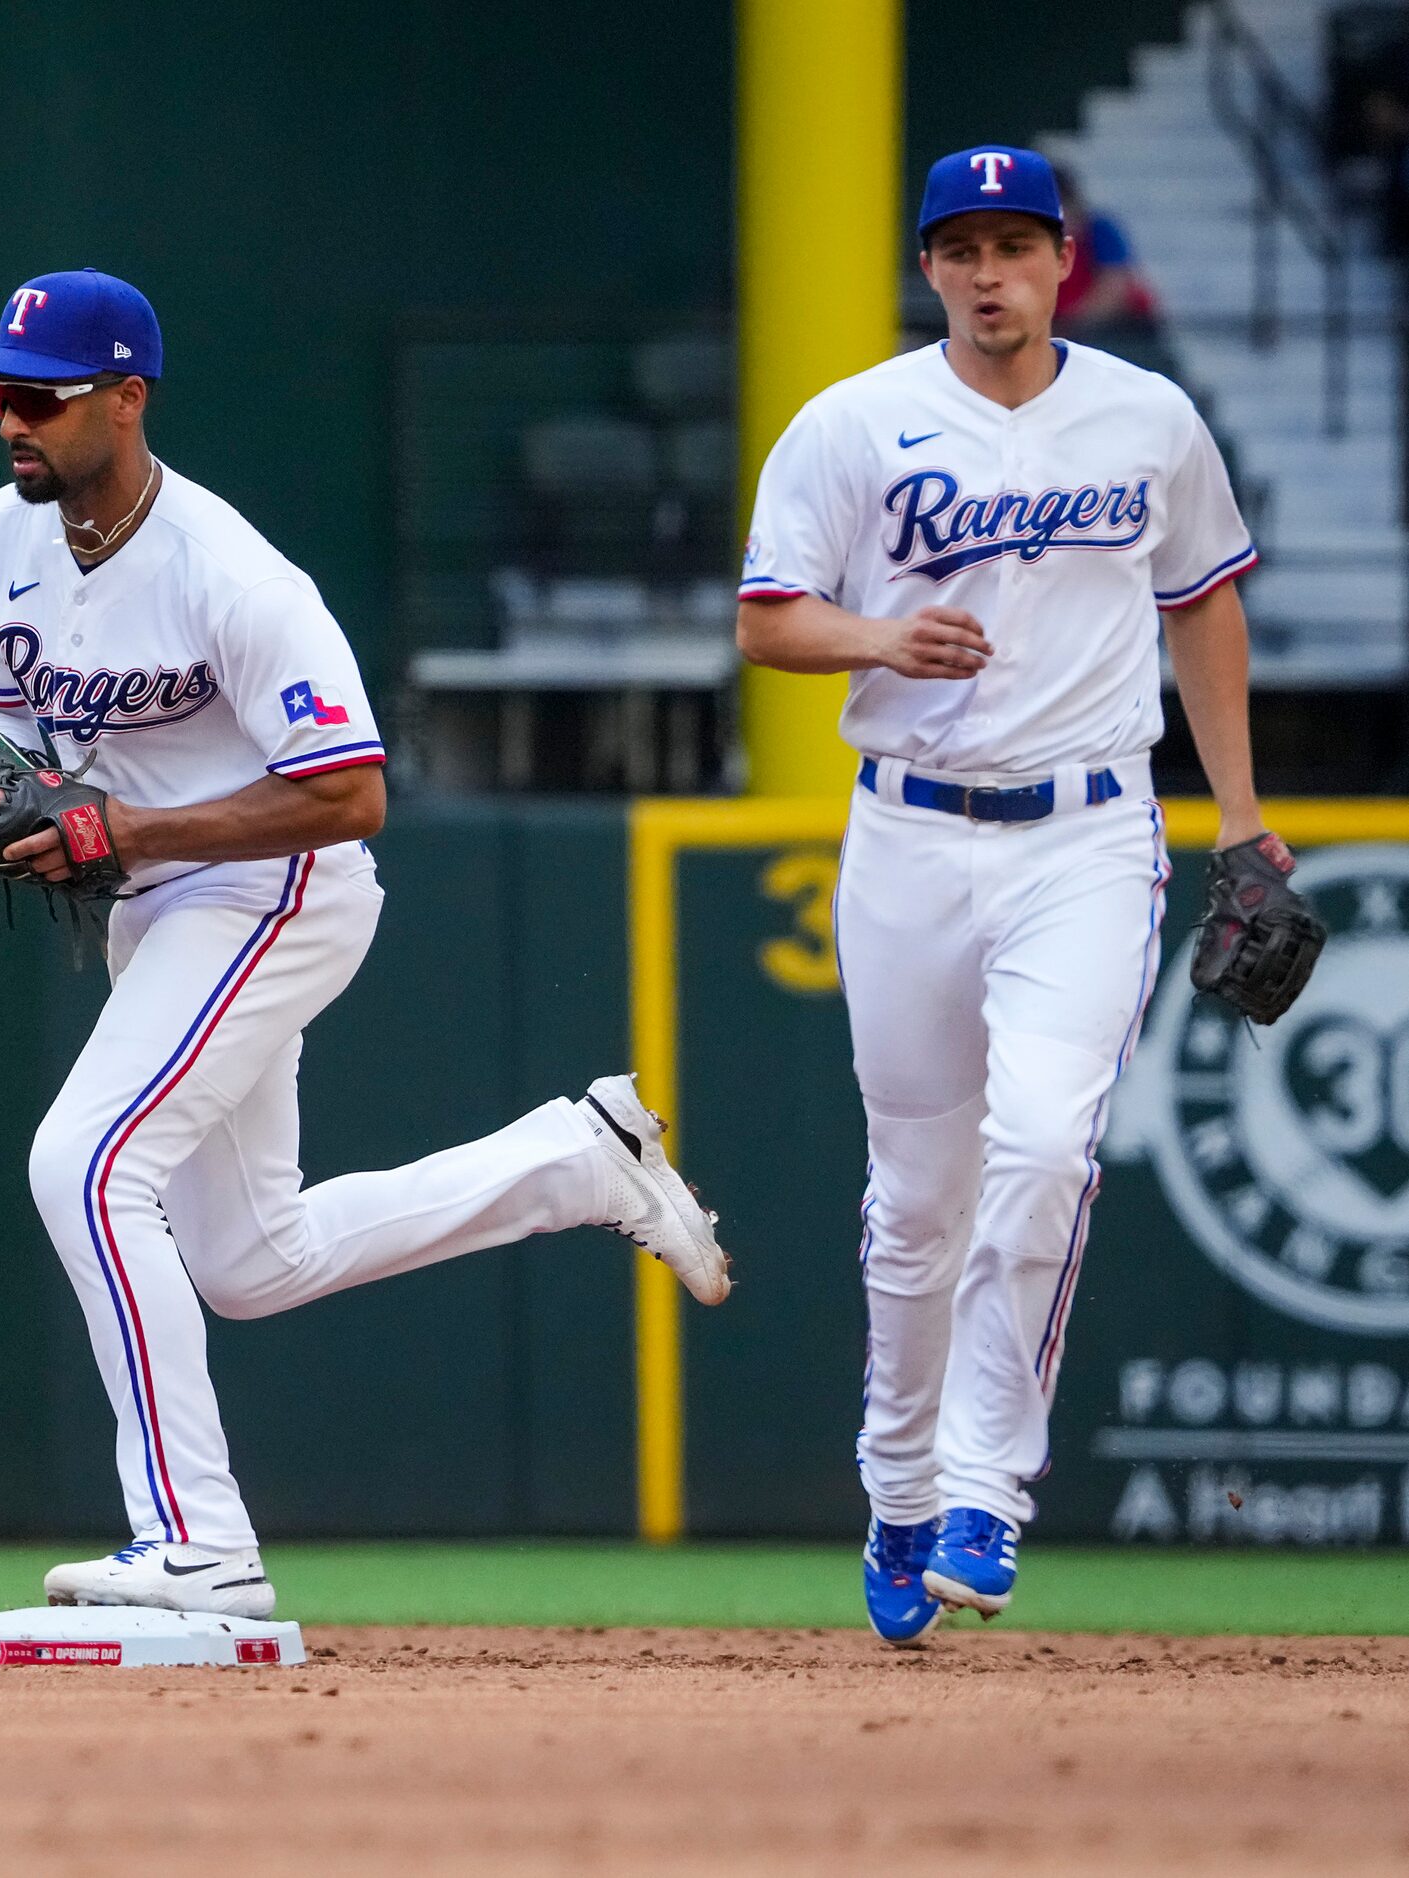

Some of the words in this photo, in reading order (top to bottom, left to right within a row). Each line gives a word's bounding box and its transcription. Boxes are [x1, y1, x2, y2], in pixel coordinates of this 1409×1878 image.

[970, 152, 1014, 195] T
[8, 288, 48, 335] T
[882, 466, 1153, 585] Rangers
[55, 1647, 100, 1660] OPENING
[101, 1648, 121, 1660] DAY
